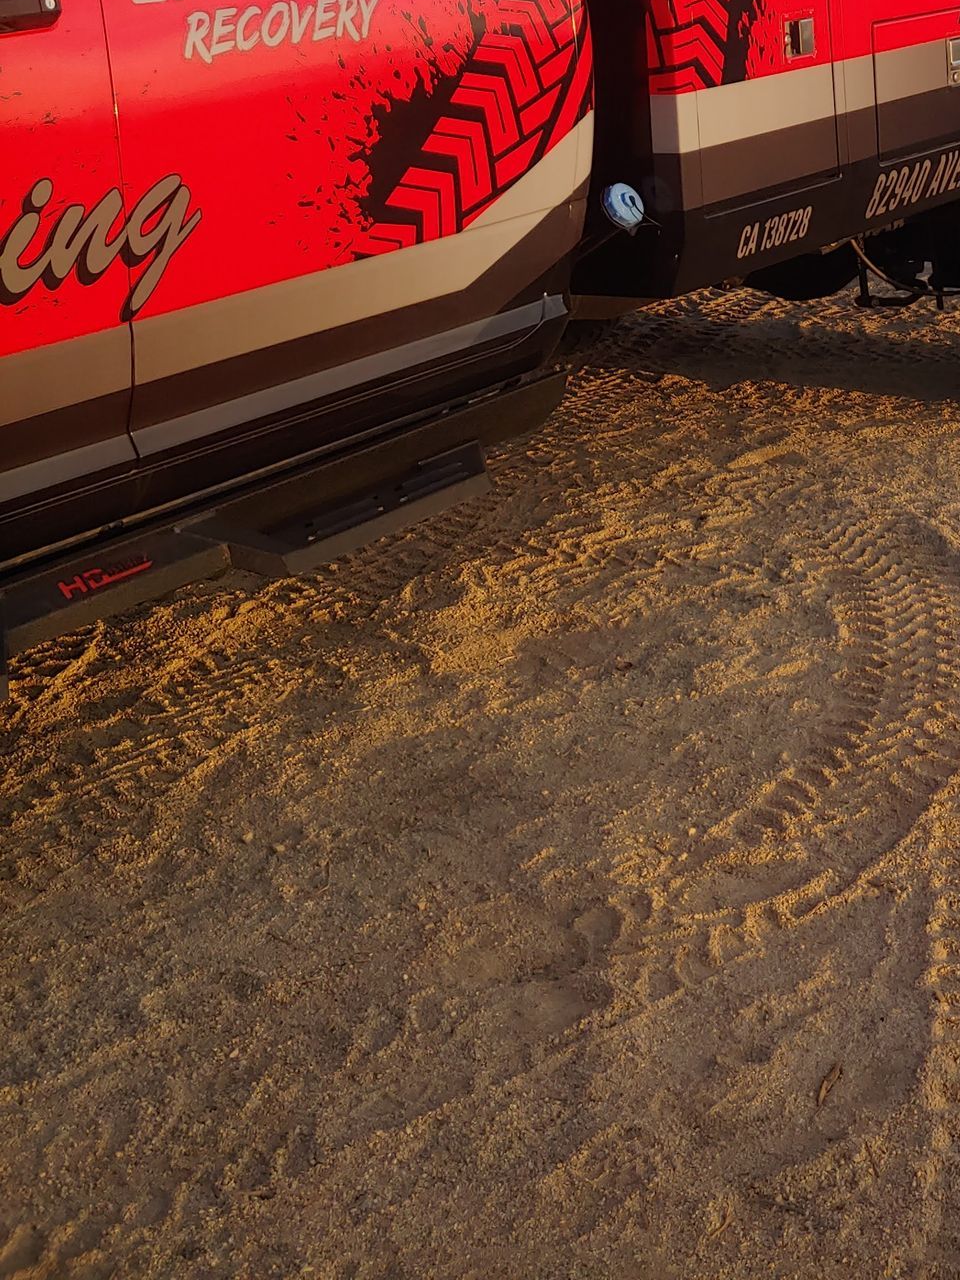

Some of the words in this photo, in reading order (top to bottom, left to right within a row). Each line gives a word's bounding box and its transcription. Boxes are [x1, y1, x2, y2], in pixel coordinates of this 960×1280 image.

[864, 158, 930, 219] 82940
[736, 222, 757, 259] CA
[760, 206, 813, 252] 138728
